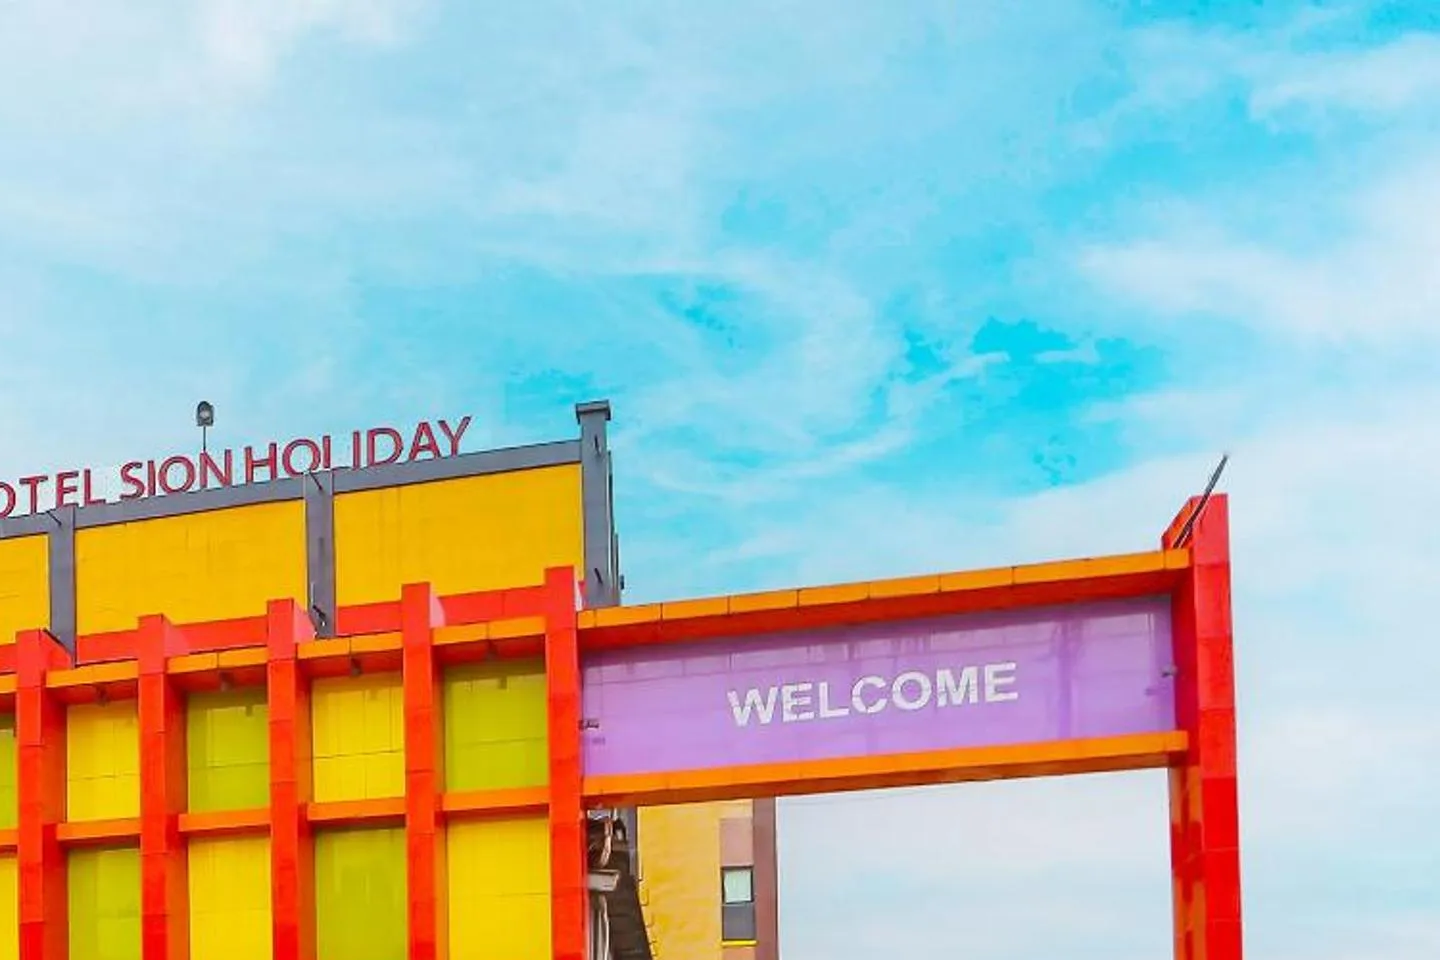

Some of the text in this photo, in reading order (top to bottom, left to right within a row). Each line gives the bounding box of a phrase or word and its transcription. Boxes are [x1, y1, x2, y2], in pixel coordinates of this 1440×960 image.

[120, 449, 232, 501] SION
[244, 416, 472, 482] HOLIDAY
[727, 662, 1019, 727] WELCOME
